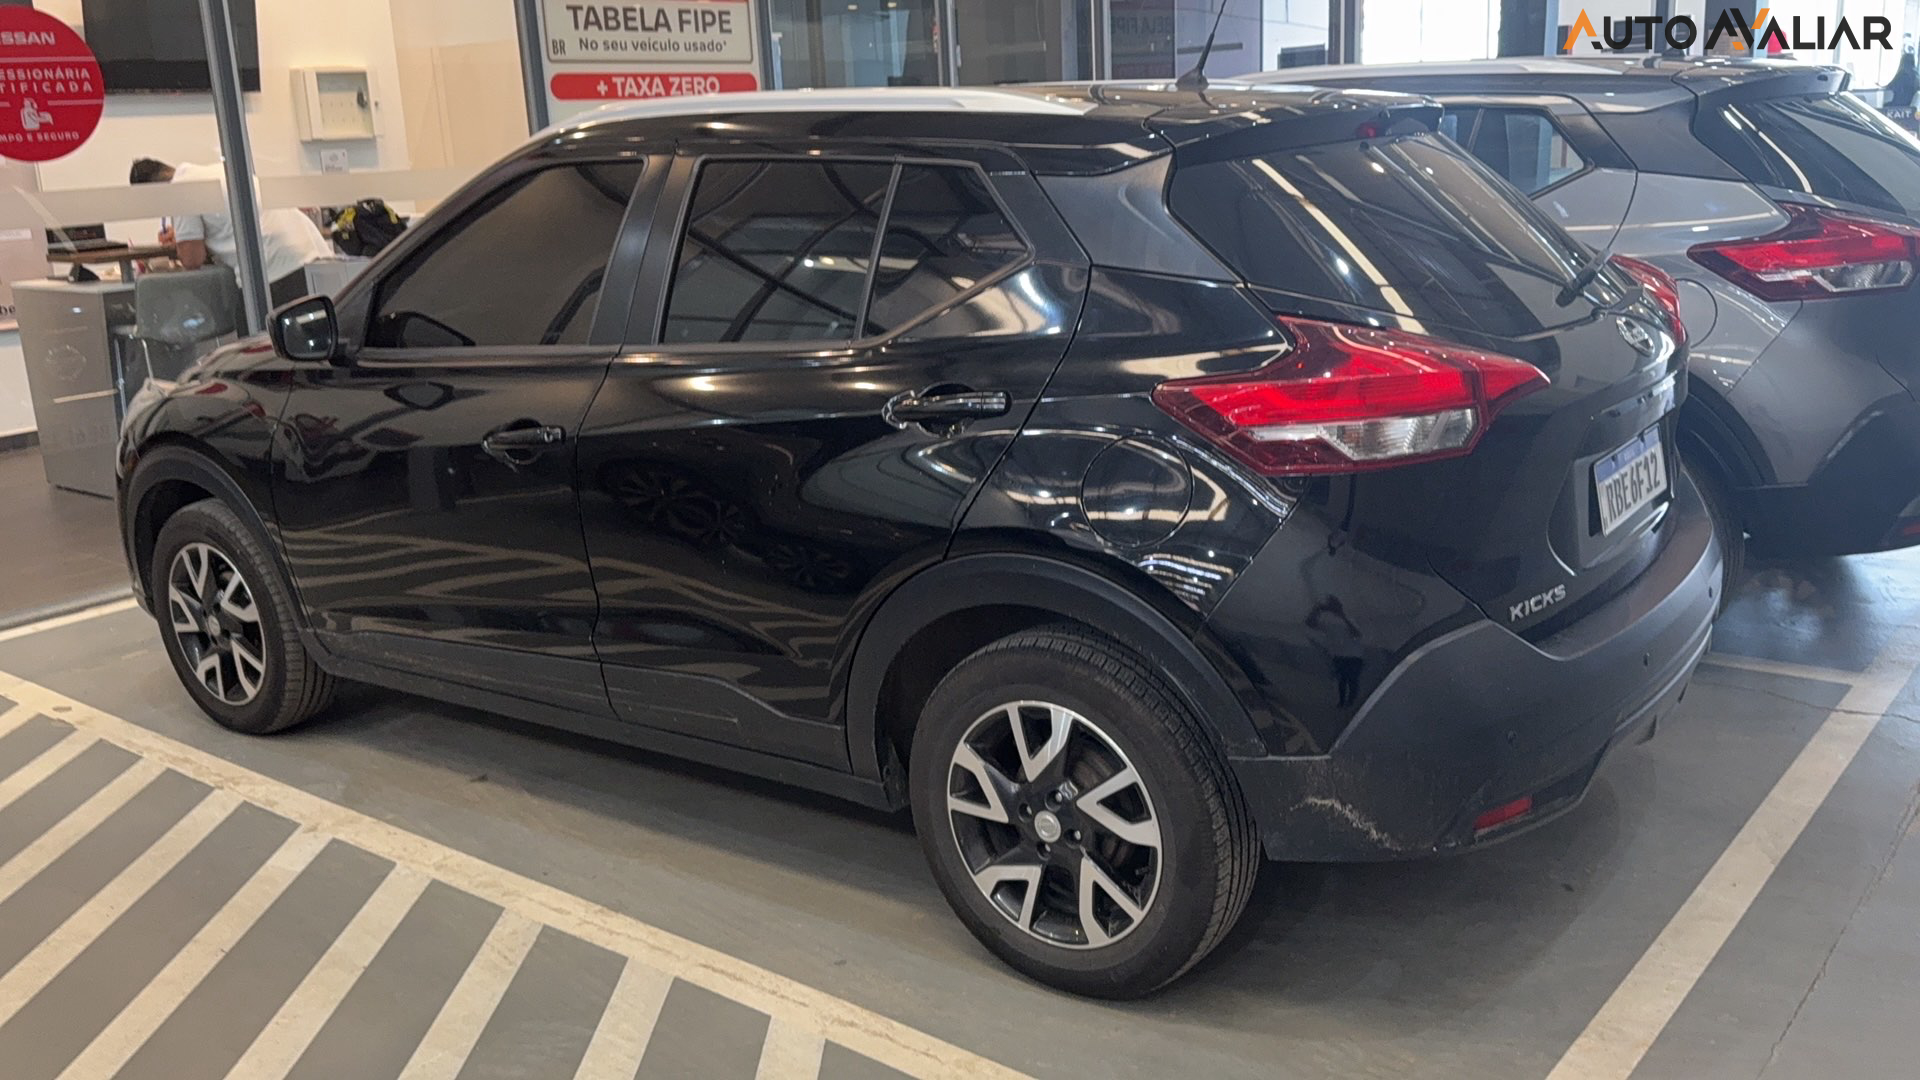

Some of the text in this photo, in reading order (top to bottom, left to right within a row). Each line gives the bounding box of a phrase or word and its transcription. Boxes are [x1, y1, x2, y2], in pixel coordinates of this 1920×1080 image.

[566, 5, 733, 34] TABELA FIPE
[0, 31, 56, 45] SSAN
[552, 39, 566, 56] BR
[579, 38, 599, 51] No
[603, 40, 628, 51] seu
[612, 76, 666, 97] TAXA
[669, 76, 721, 96] ZERO
[36, 131, 80, 142] SEGURO
[1606, 451, 1661, 522] RBE6F12
[1509, 584, 1567, 622] KICKS
